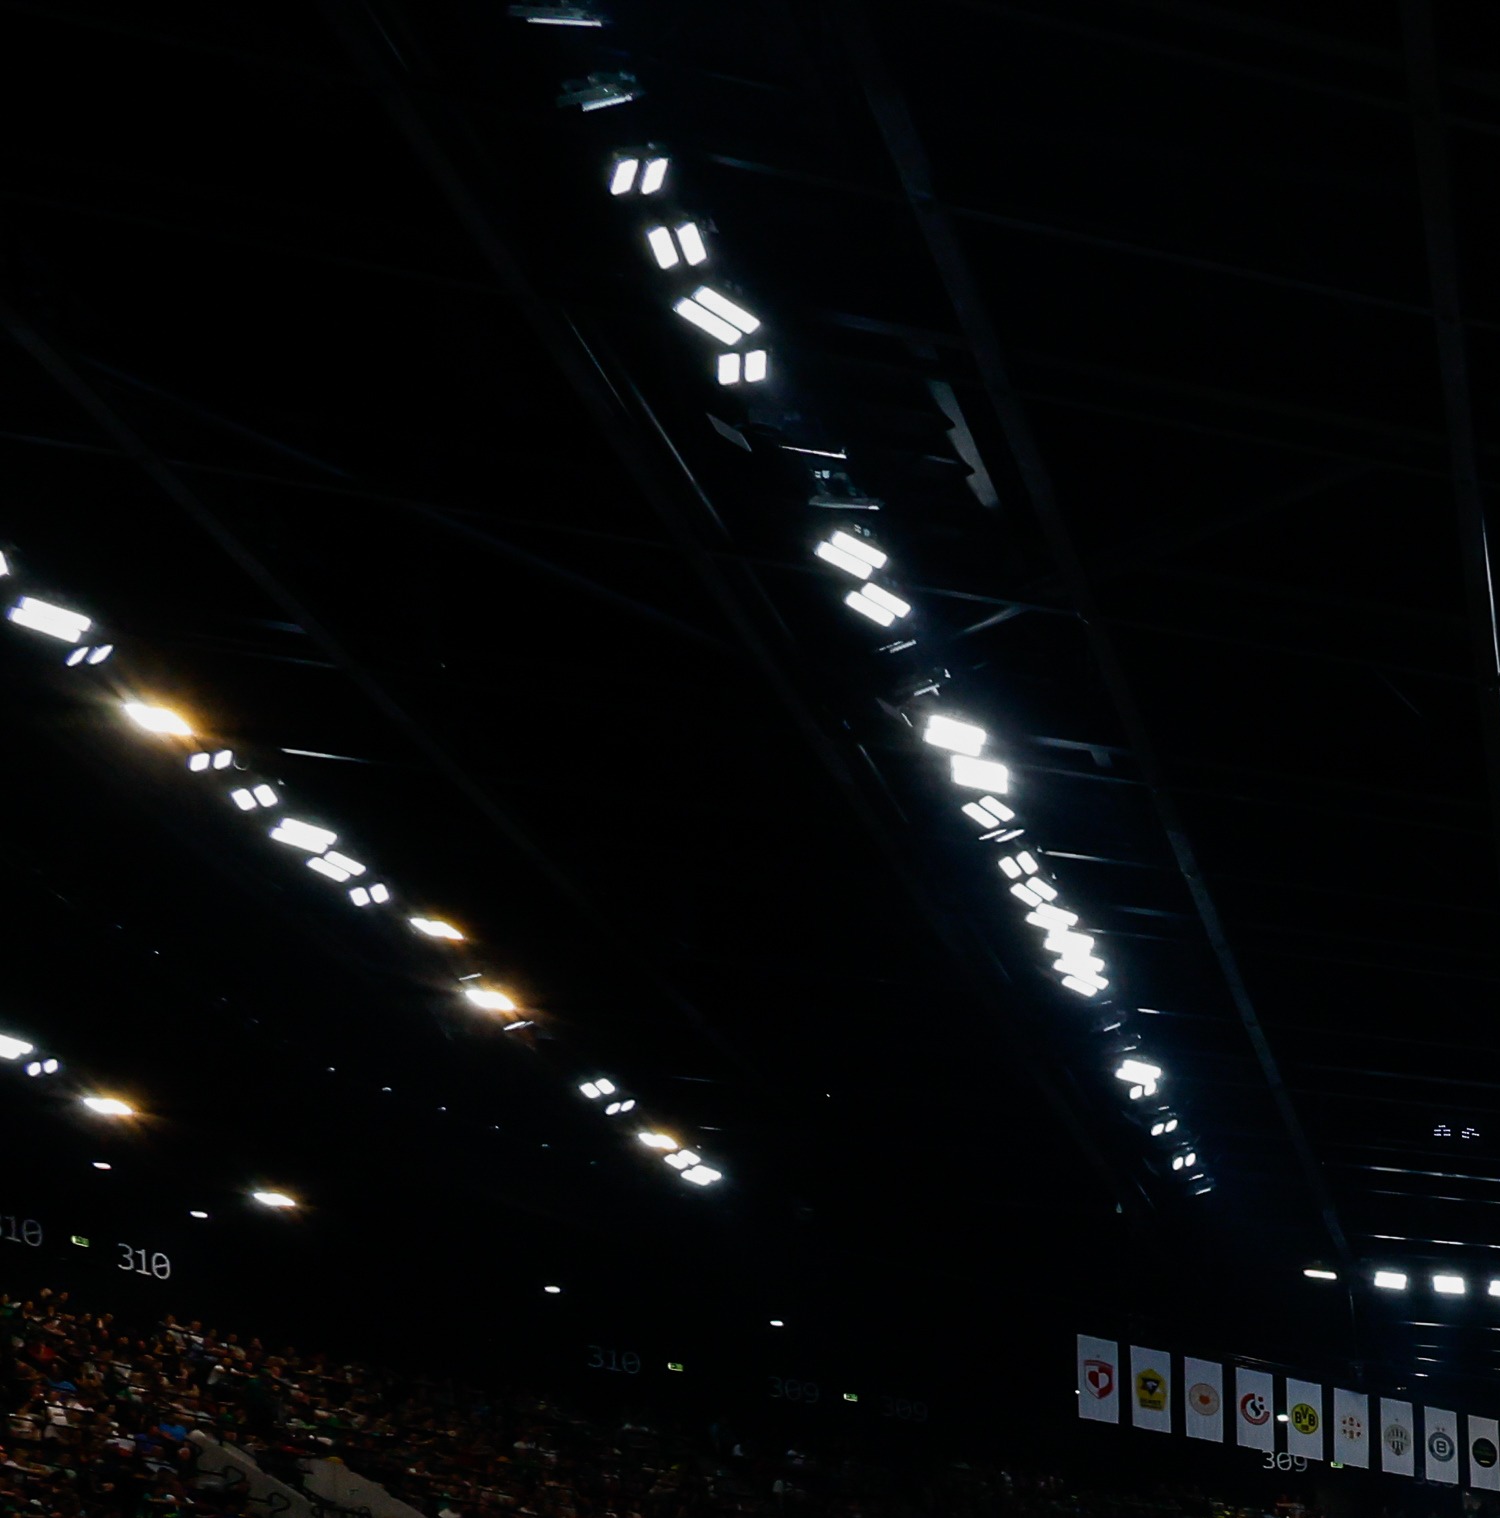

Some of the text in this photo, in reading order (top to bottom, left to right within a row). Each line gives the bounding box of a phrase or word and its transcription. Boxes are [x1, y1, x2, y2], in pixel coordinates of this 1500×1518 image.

[117, 1243, 171, 1280] 310
[587, 1347, 641, 1375] 310
[1262, 1451, 1308, 1472] 309
